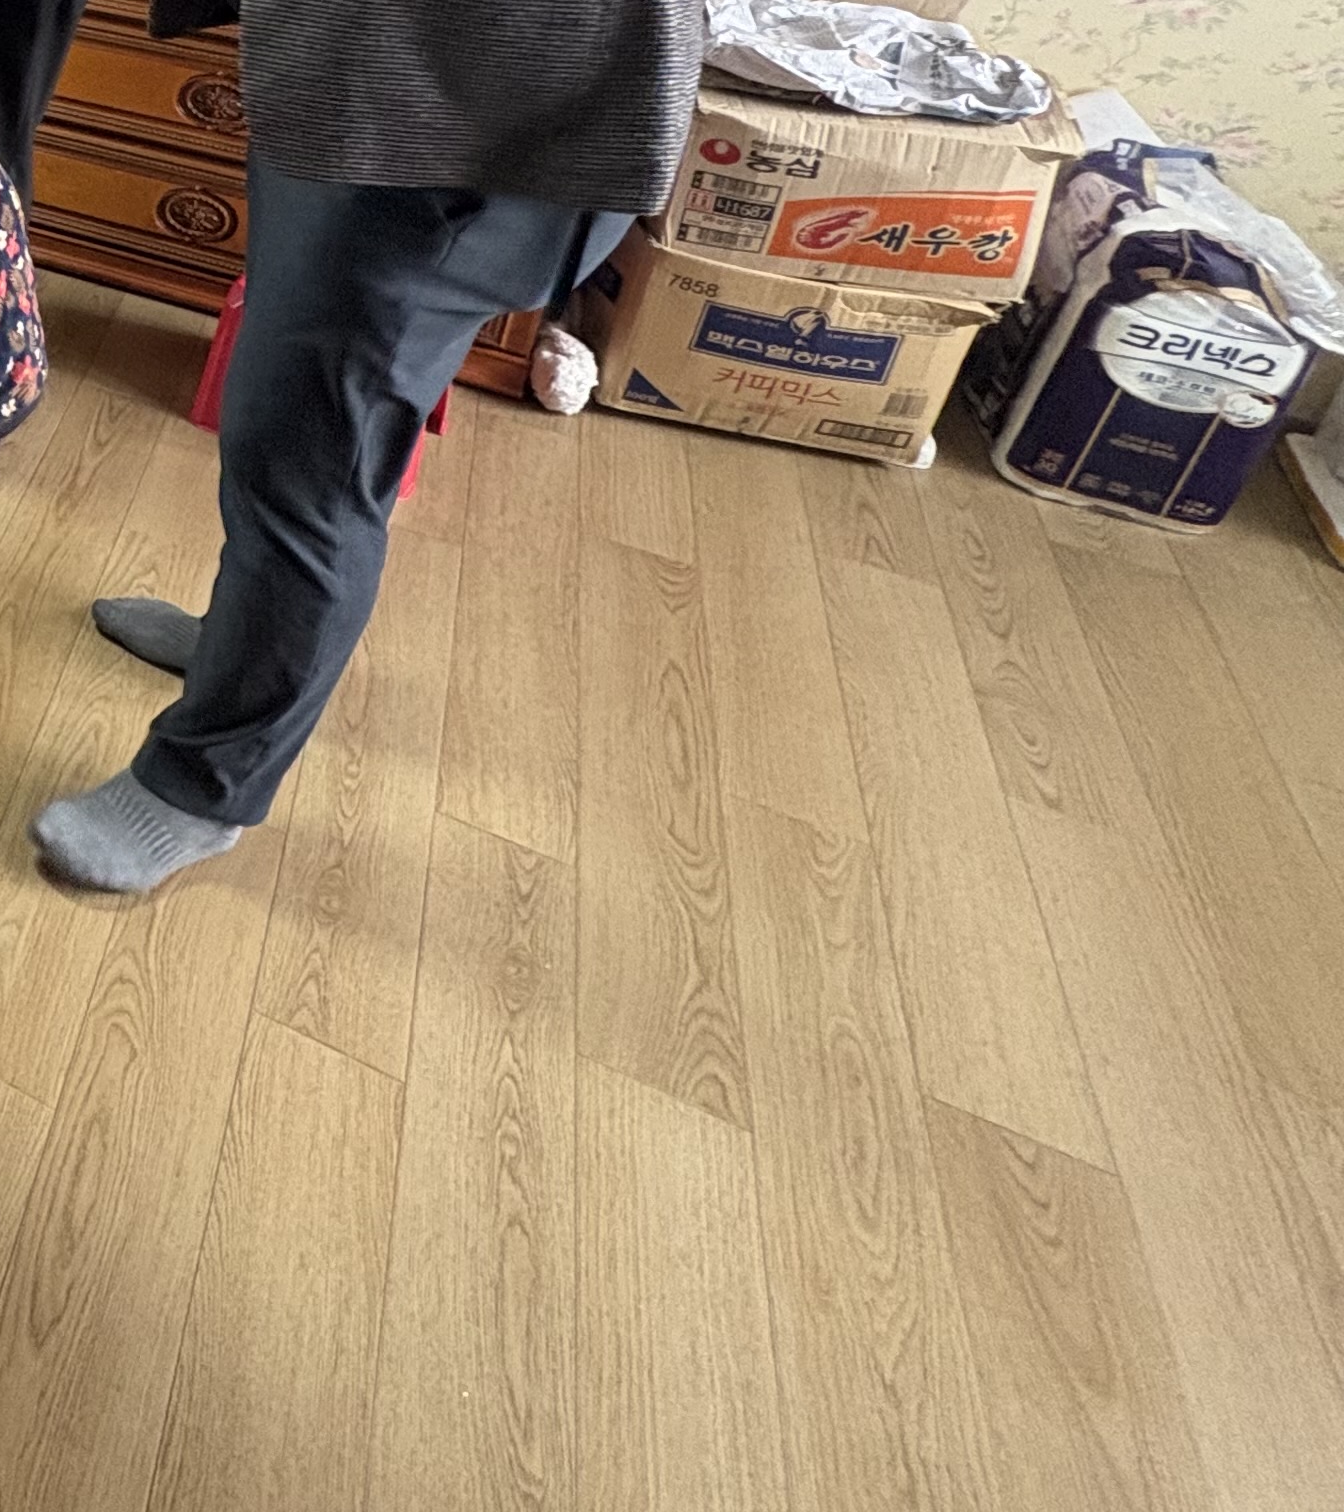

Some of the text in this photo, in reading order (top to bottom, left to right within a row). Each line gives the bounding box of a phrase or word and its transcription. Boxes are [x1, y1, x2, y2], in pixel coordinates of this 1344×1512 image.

[746, 150, 821, 179] 농심
[858, 223, 1014, 261] 새우깡
[668, 274, 720, 298] 7858
[706, 330, 877, 372] 맥스웰하우스
[1115, 323, 1278, 377] 크리넥스
[713, 367, 843, 407] 커피믹스
